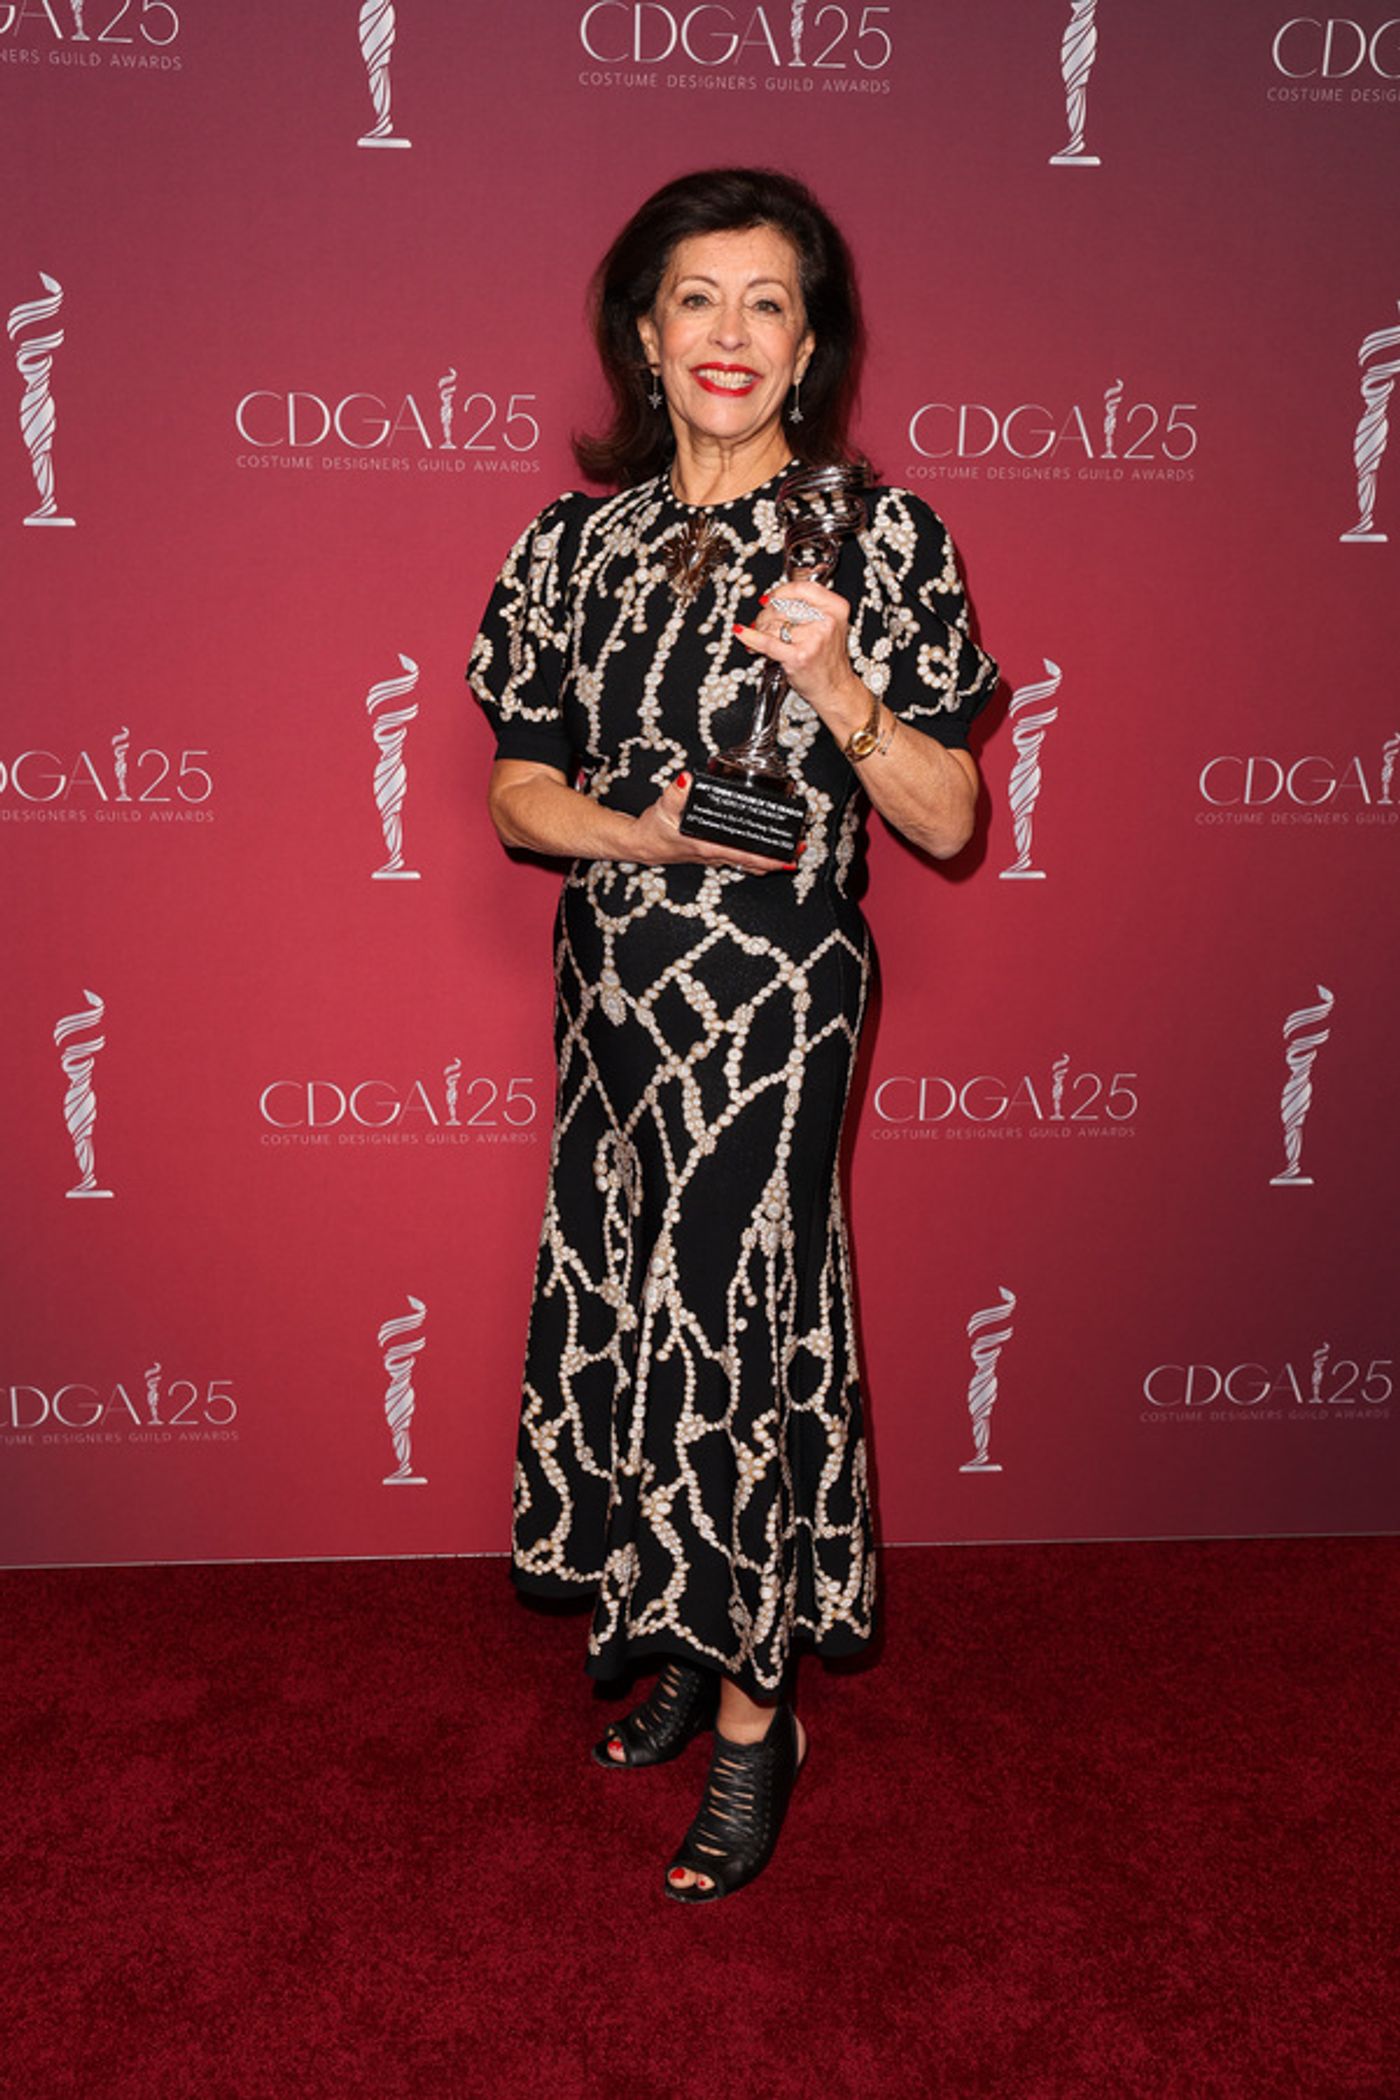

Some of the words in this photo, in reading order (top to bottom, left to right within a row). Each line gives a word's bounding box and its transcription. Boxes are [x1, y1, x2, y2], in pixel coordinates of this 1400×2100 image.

[49, 50, 101, 67] GUILD
[110, 53, 183, 71] AWARDS
[578, 71, 657, 88] COSTUME
[667, 74, 757, 90] DESIGNERS
[764, 77, 814, 92] GUILD
[822, 79, 891, 94] AWARDS
[1266, 87, 1343, 102] COSTUME
[1351, 88, 1400, 102] DESIG
[236, 455, 313, 469] COSTUME
[322, 456, 410, 471] DESIGNERS
[417, 457, 466, 472] GUILD
[473, 459, 541, 473] AWARDS
[905, 465, 979, 480] COSTUME
[987, 465, 1070, 480] DESIGNERS
[1078, 467, 1124, 481] GUILD
[1131, 468, 1195, 482] AWARDS
[2, 809, 88, 823] DESIGNERS
[95, 809, 142, 823] GUILD
[149, 809, 215, 823] AWARDS
[1194, 811, 1265, 825] COSTUME
[1271, 811, 1349, 825] DESIGNERS
[1355, 811, 1400, 825] GUILD
[260, 1133, 330, 1145] COSTUME
[338, 1133, 419, 1146] DESIGNERS
[425, 1133, 469, 1145] GUILD
[476, 1132, 538, 1145] AWARDS
[872, 1127, 938, 1140] COSTUME
[946, 1126, 1023, 1140] DESIGNERS
[1029, 1126, 1071, 1139] GUILD
[1078, 1125, 1136, 1138] AWARDS
[0, 1383, 141, 1428] DGA
[1140, 1411, 1203, 1423] COSTUME
[1210, 1408, 1283, 1422] DESIGNERS
[1288, 1408, 1329, 1421] GUILD
[1335, 1406, 1390, 1420] AWARDS
[42, 1432, 122, 1445] DESIGNERS
[128, 1431, 172, 1444] GUILD
[178, 1429, 240, 1442] AWARDS
